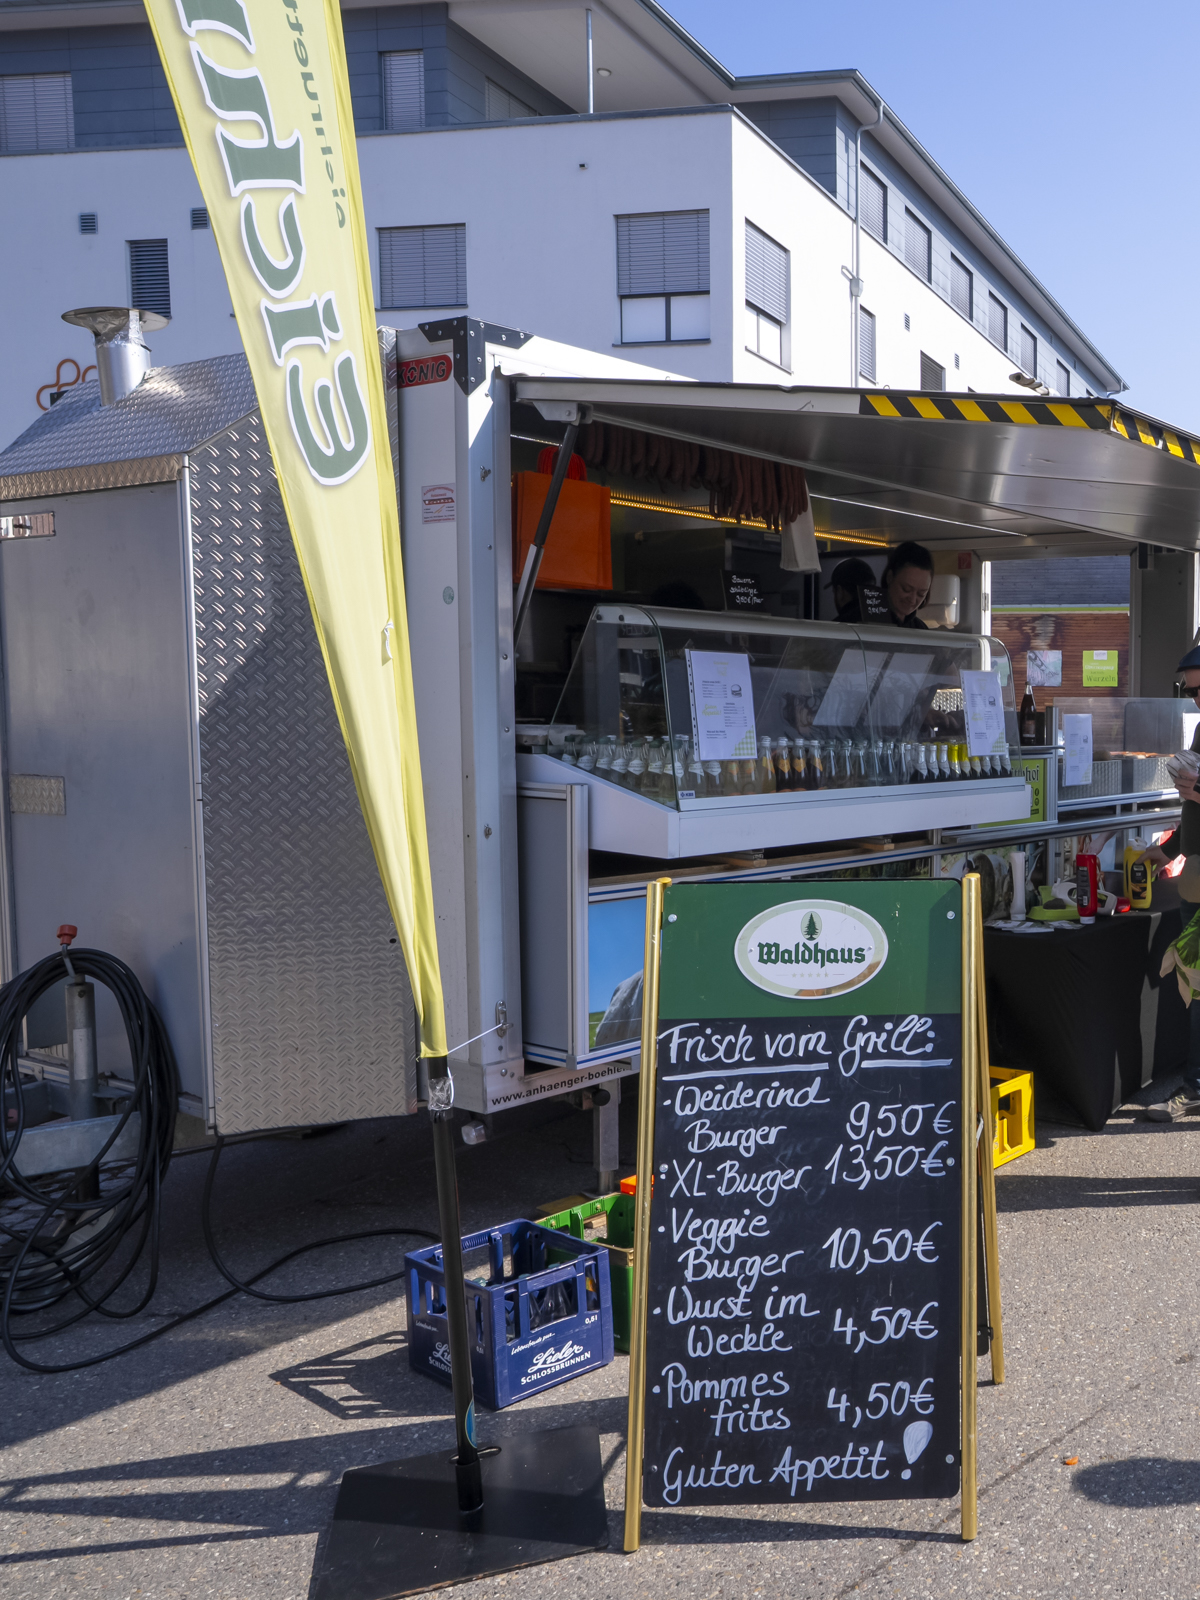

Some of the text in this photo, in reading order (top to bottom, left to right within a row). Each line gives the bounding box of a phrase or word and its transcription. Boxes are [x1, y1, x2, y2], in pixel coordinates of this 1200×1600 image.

[397, 360, 447, 386] KÖNIG
[757, 941, 867, 969] Waldhaus
[658, 1014, 936, 1078] Frisch vom Grill:
[491, 1066, 627, 1106] www.anhaenger-boehle
[674, 1076, 831, 1117] Weiderind
[683, 1118, 788, 1158] Burger
[669, 1156, 812, 1207] XL-Burger
[671, 1207, 771, 1255] Veggie
[677, 1221, 943, 1293] Burger 10,50€
[666, 1285, 820, 1326] Wurst im
[687, 1301, 939, 1358] Weckle 4,50€
[520, 1351, 592, 1386] SCHLOSSBRUNNEN
[660, 1362, 790, 1408] Pommes
[709, 1377, 935, 1437] frites 4,50€
[661, 1446, 762, 1505] Guten
